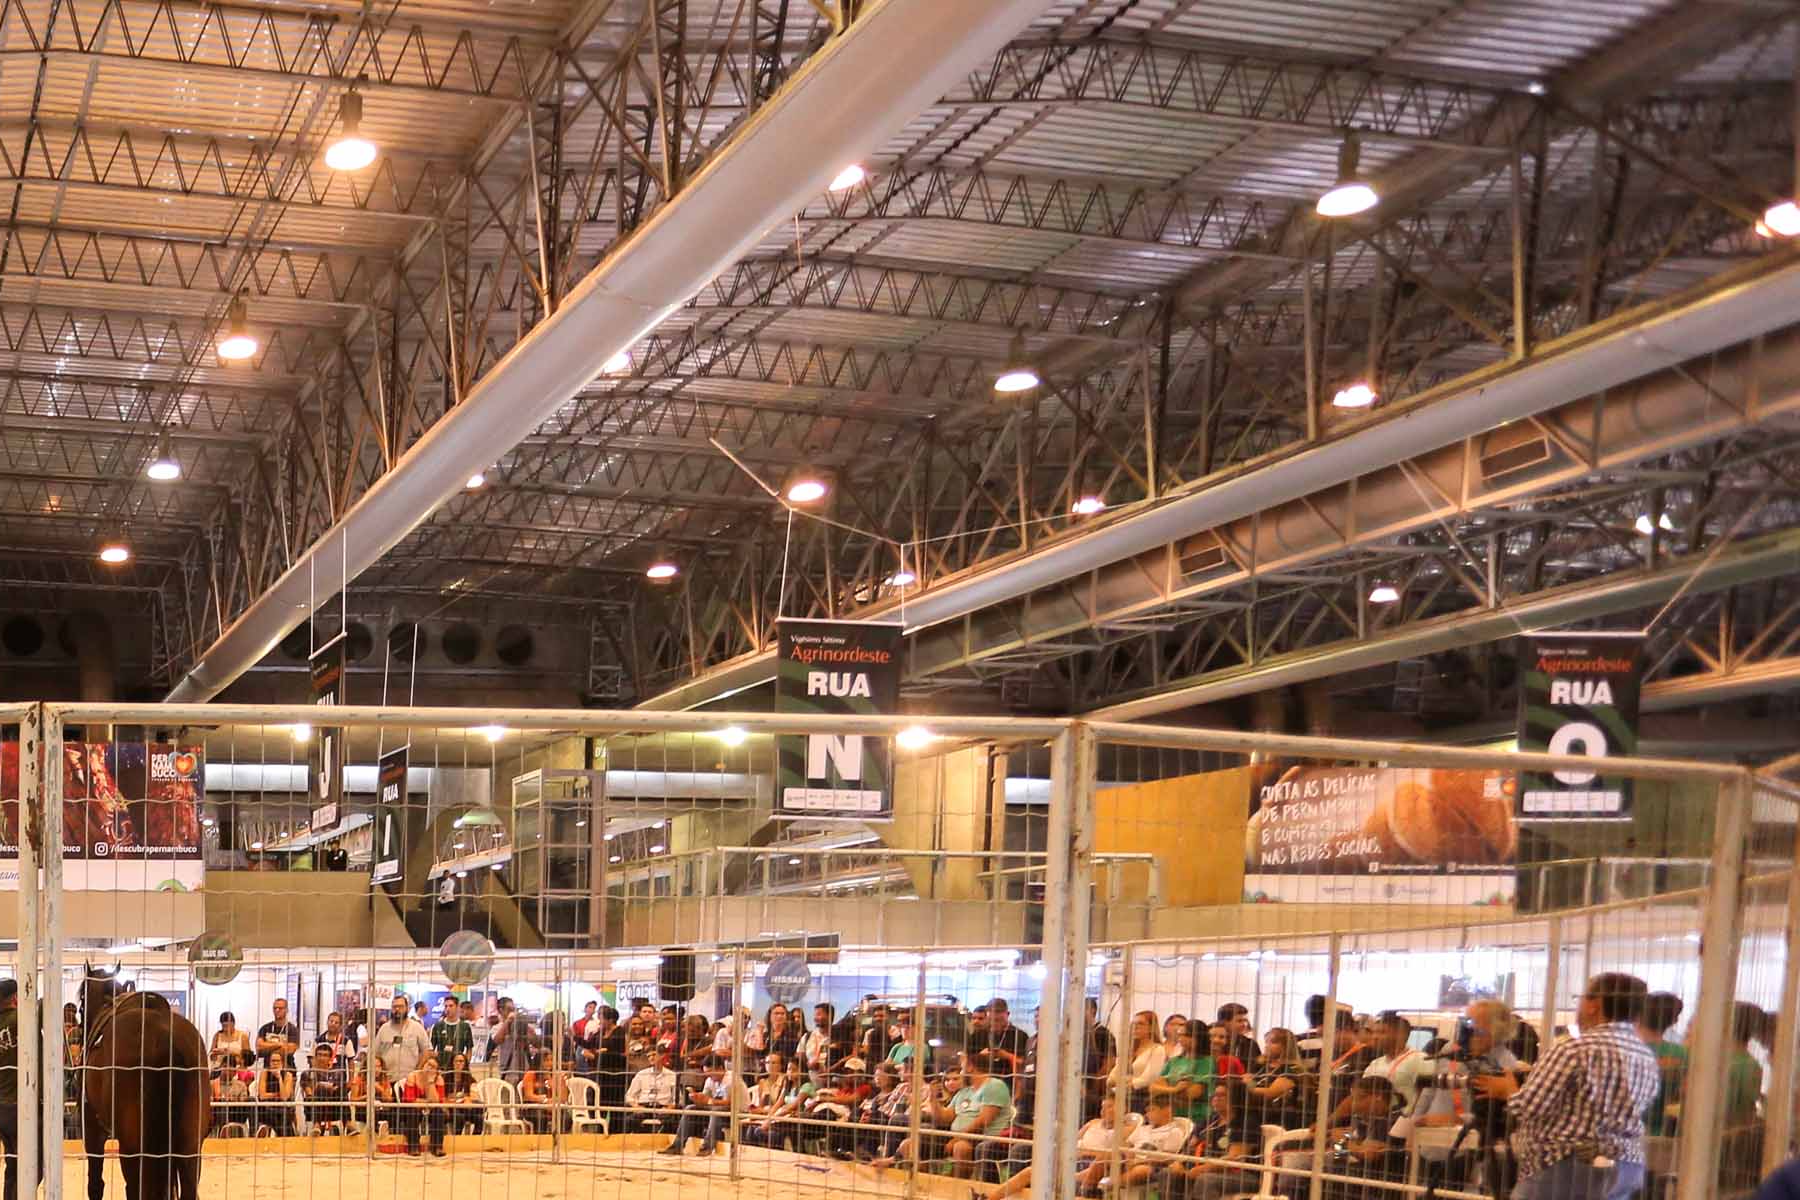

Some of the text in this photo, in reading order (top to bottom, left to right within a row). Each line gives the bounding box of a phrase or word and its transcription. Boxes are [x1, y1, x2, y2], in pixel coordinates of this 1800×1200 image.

[790, 645, 890, 664] Agrinordeste
[807, 671, 871, 697] RUA
[1550, 680, 1613, 706] RUA
[807, 733, 863, 781] N
[1303, 780, 1320, 799] AS
[1323, 773, 1377, 796] DELÍCIAS
[1261, 805, 1280, 823] DE
[1261, 829, 1271, 846] E
[1261, 848, 1286, 866] NAS
[1290, 841, 1331, 864] REDES
